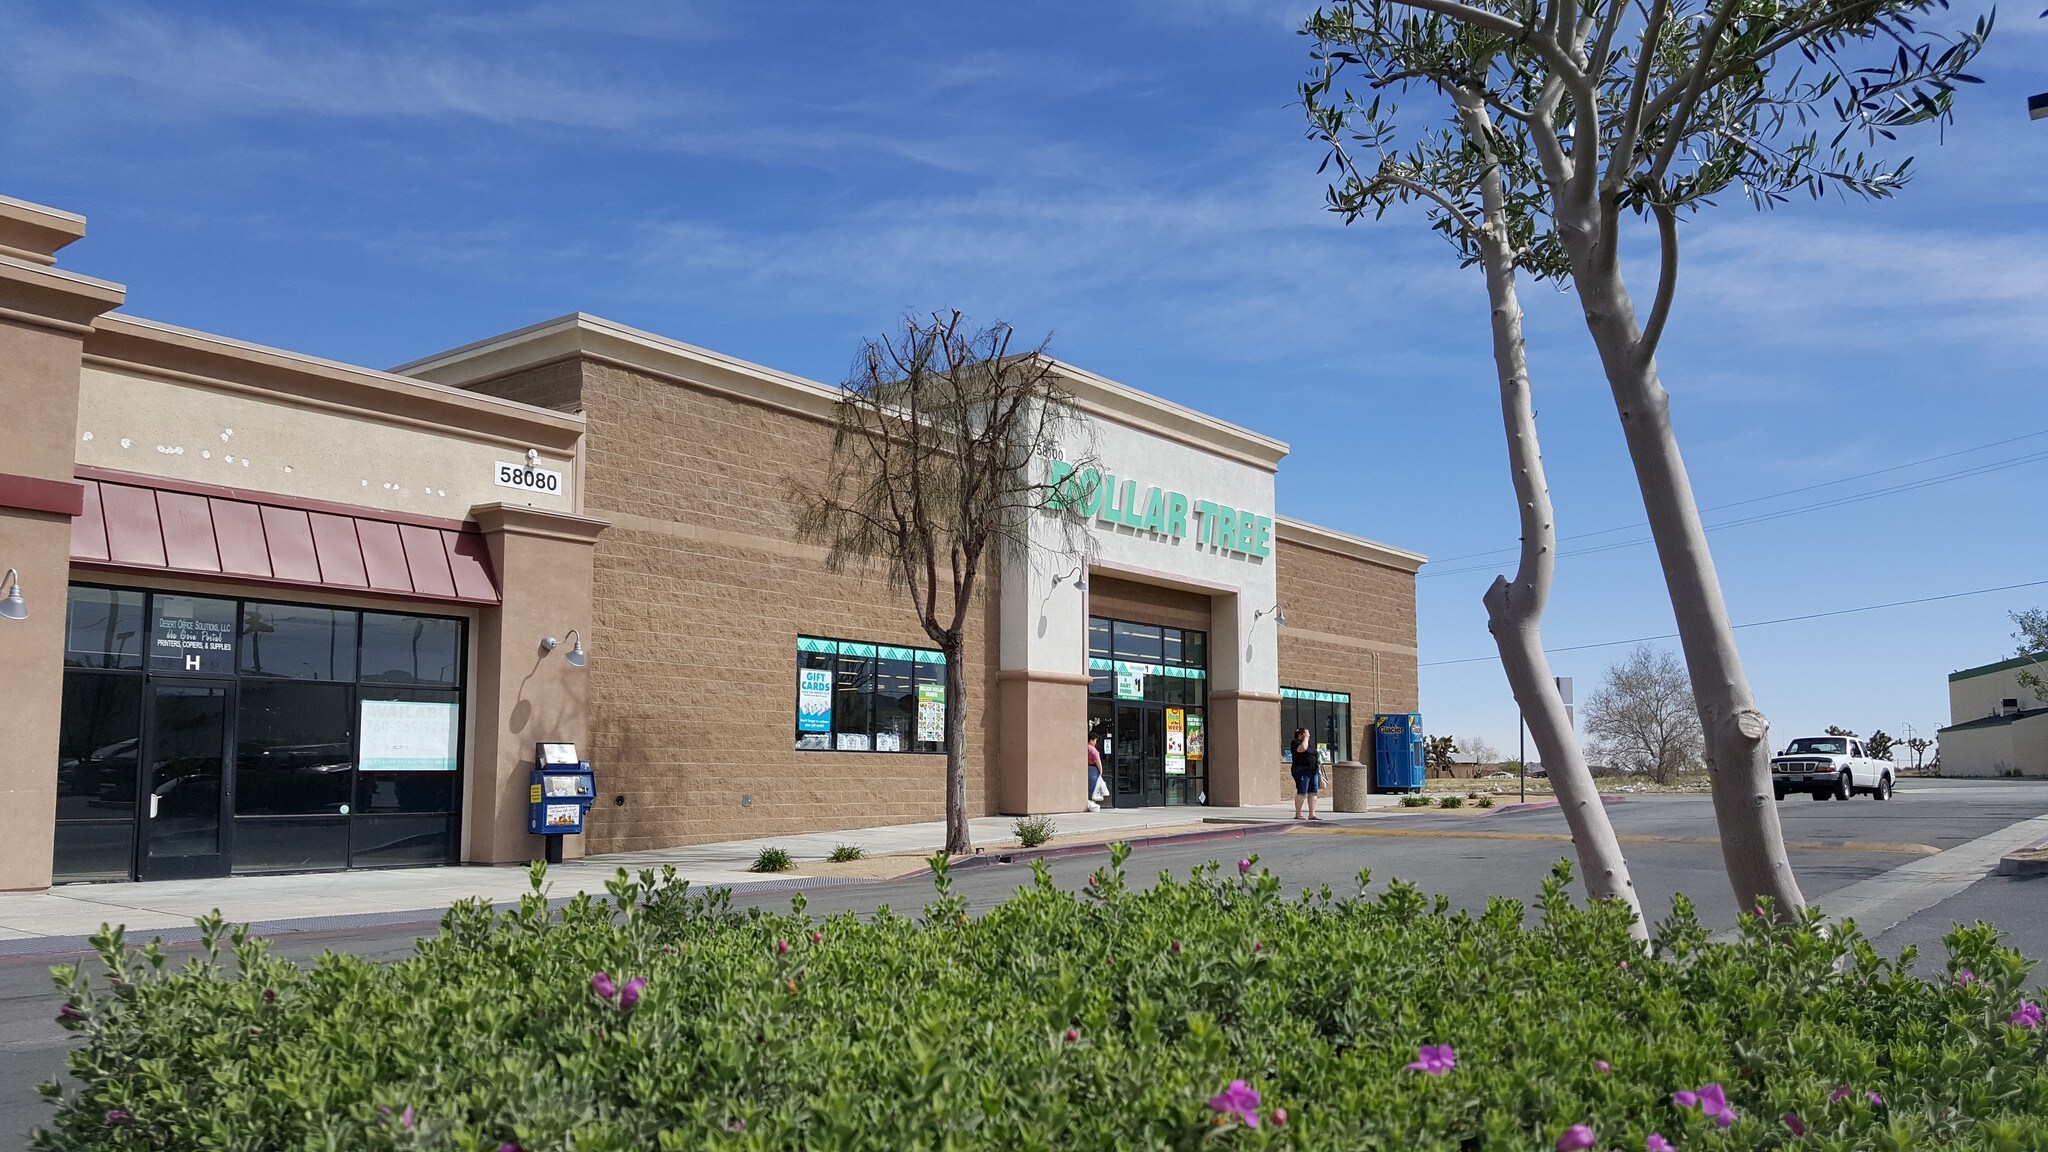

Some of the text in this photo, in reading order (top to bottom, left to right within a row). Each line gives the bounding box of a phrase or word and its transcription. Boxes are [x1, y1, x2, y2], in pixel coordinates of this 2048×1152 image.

[500, 466, 557, 491] 58080
[1046, 459, 1272, 557] DOLLAR TREE
[220, 624, 231, 632] LLC
[157, 639, 181, 648] PRINTERS,
[182, 641, 204, 650] COPIERS,
[210, 643, 232, 651] SUPPLIES
[186, 655, 200, 670] H
[806, 672, 825, 682] GIFT
[802, 681, 830, 692] CARDS
[365, 704, 457, 719] AVAILABL
[365, 719, 457, 734] 760-369-971
[1379, 726, 1404, 734] Glacier
